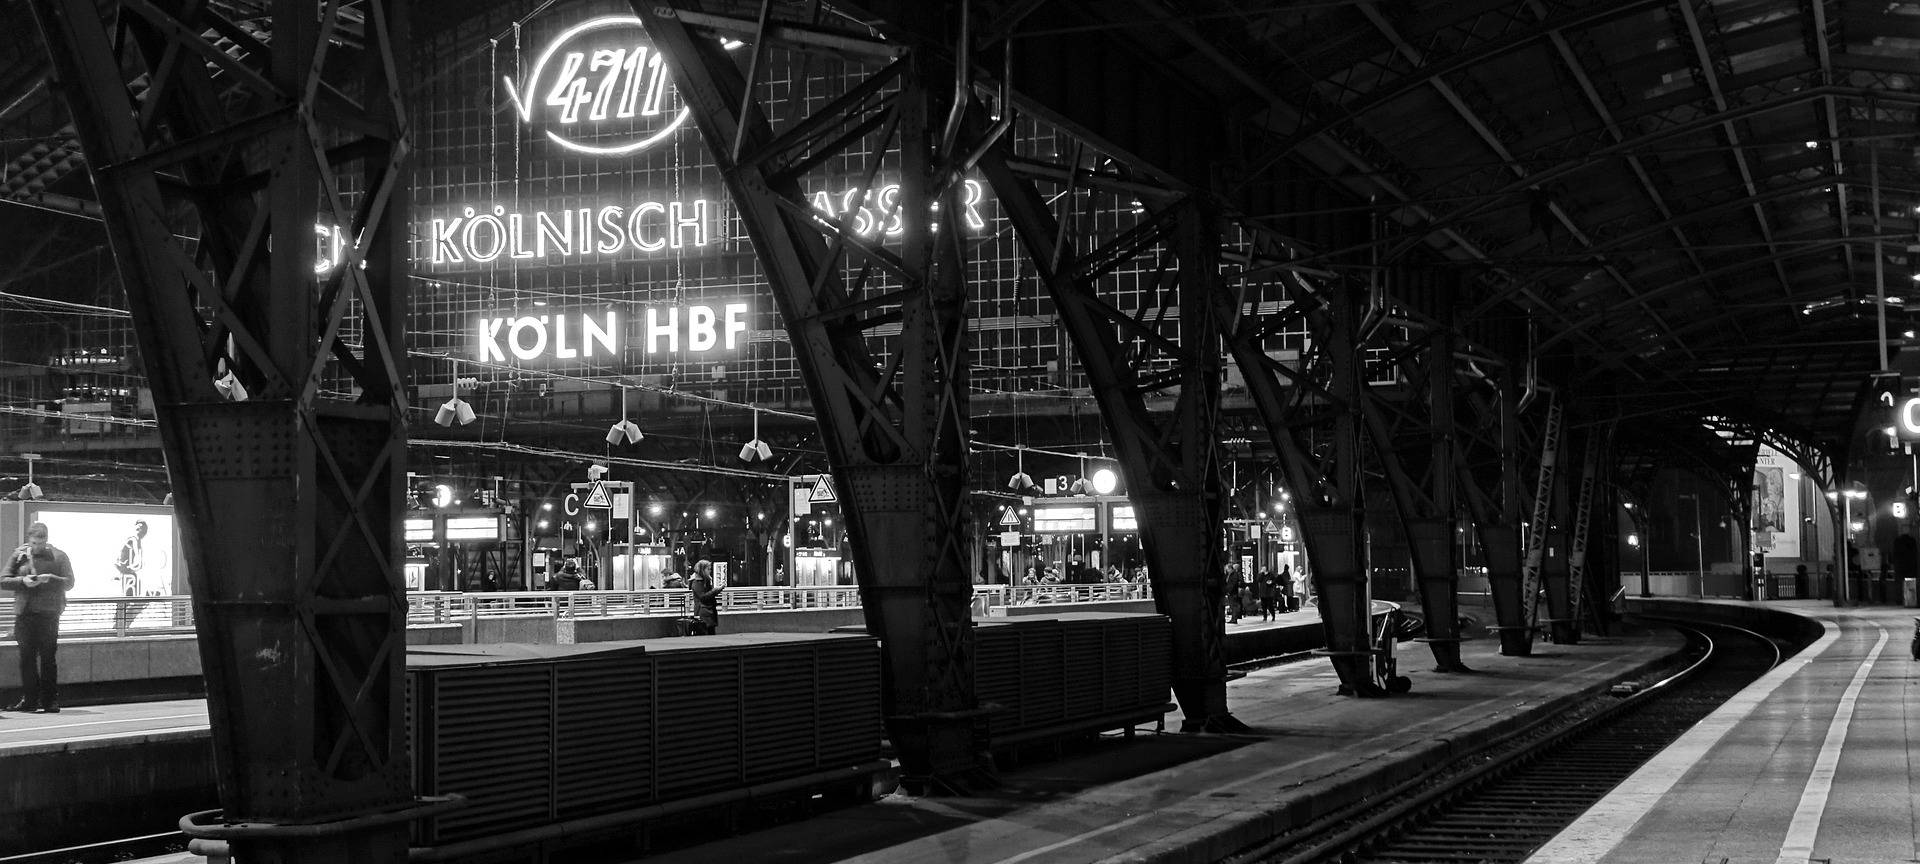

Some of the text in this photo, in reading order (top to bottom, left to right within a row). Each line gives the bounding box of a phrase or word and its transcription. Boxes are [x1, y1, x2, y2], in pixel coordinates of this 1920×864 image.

[546, 46, 667, 123] 4711
[431, 199, 708, 264] KÖLNISCH
[478, 303, 748, 363] KÖLN HBF
[1058, 475, 1068, 491] 3
[564, 493, 579, 516] C
[1892, 502, 1906, 518] B
